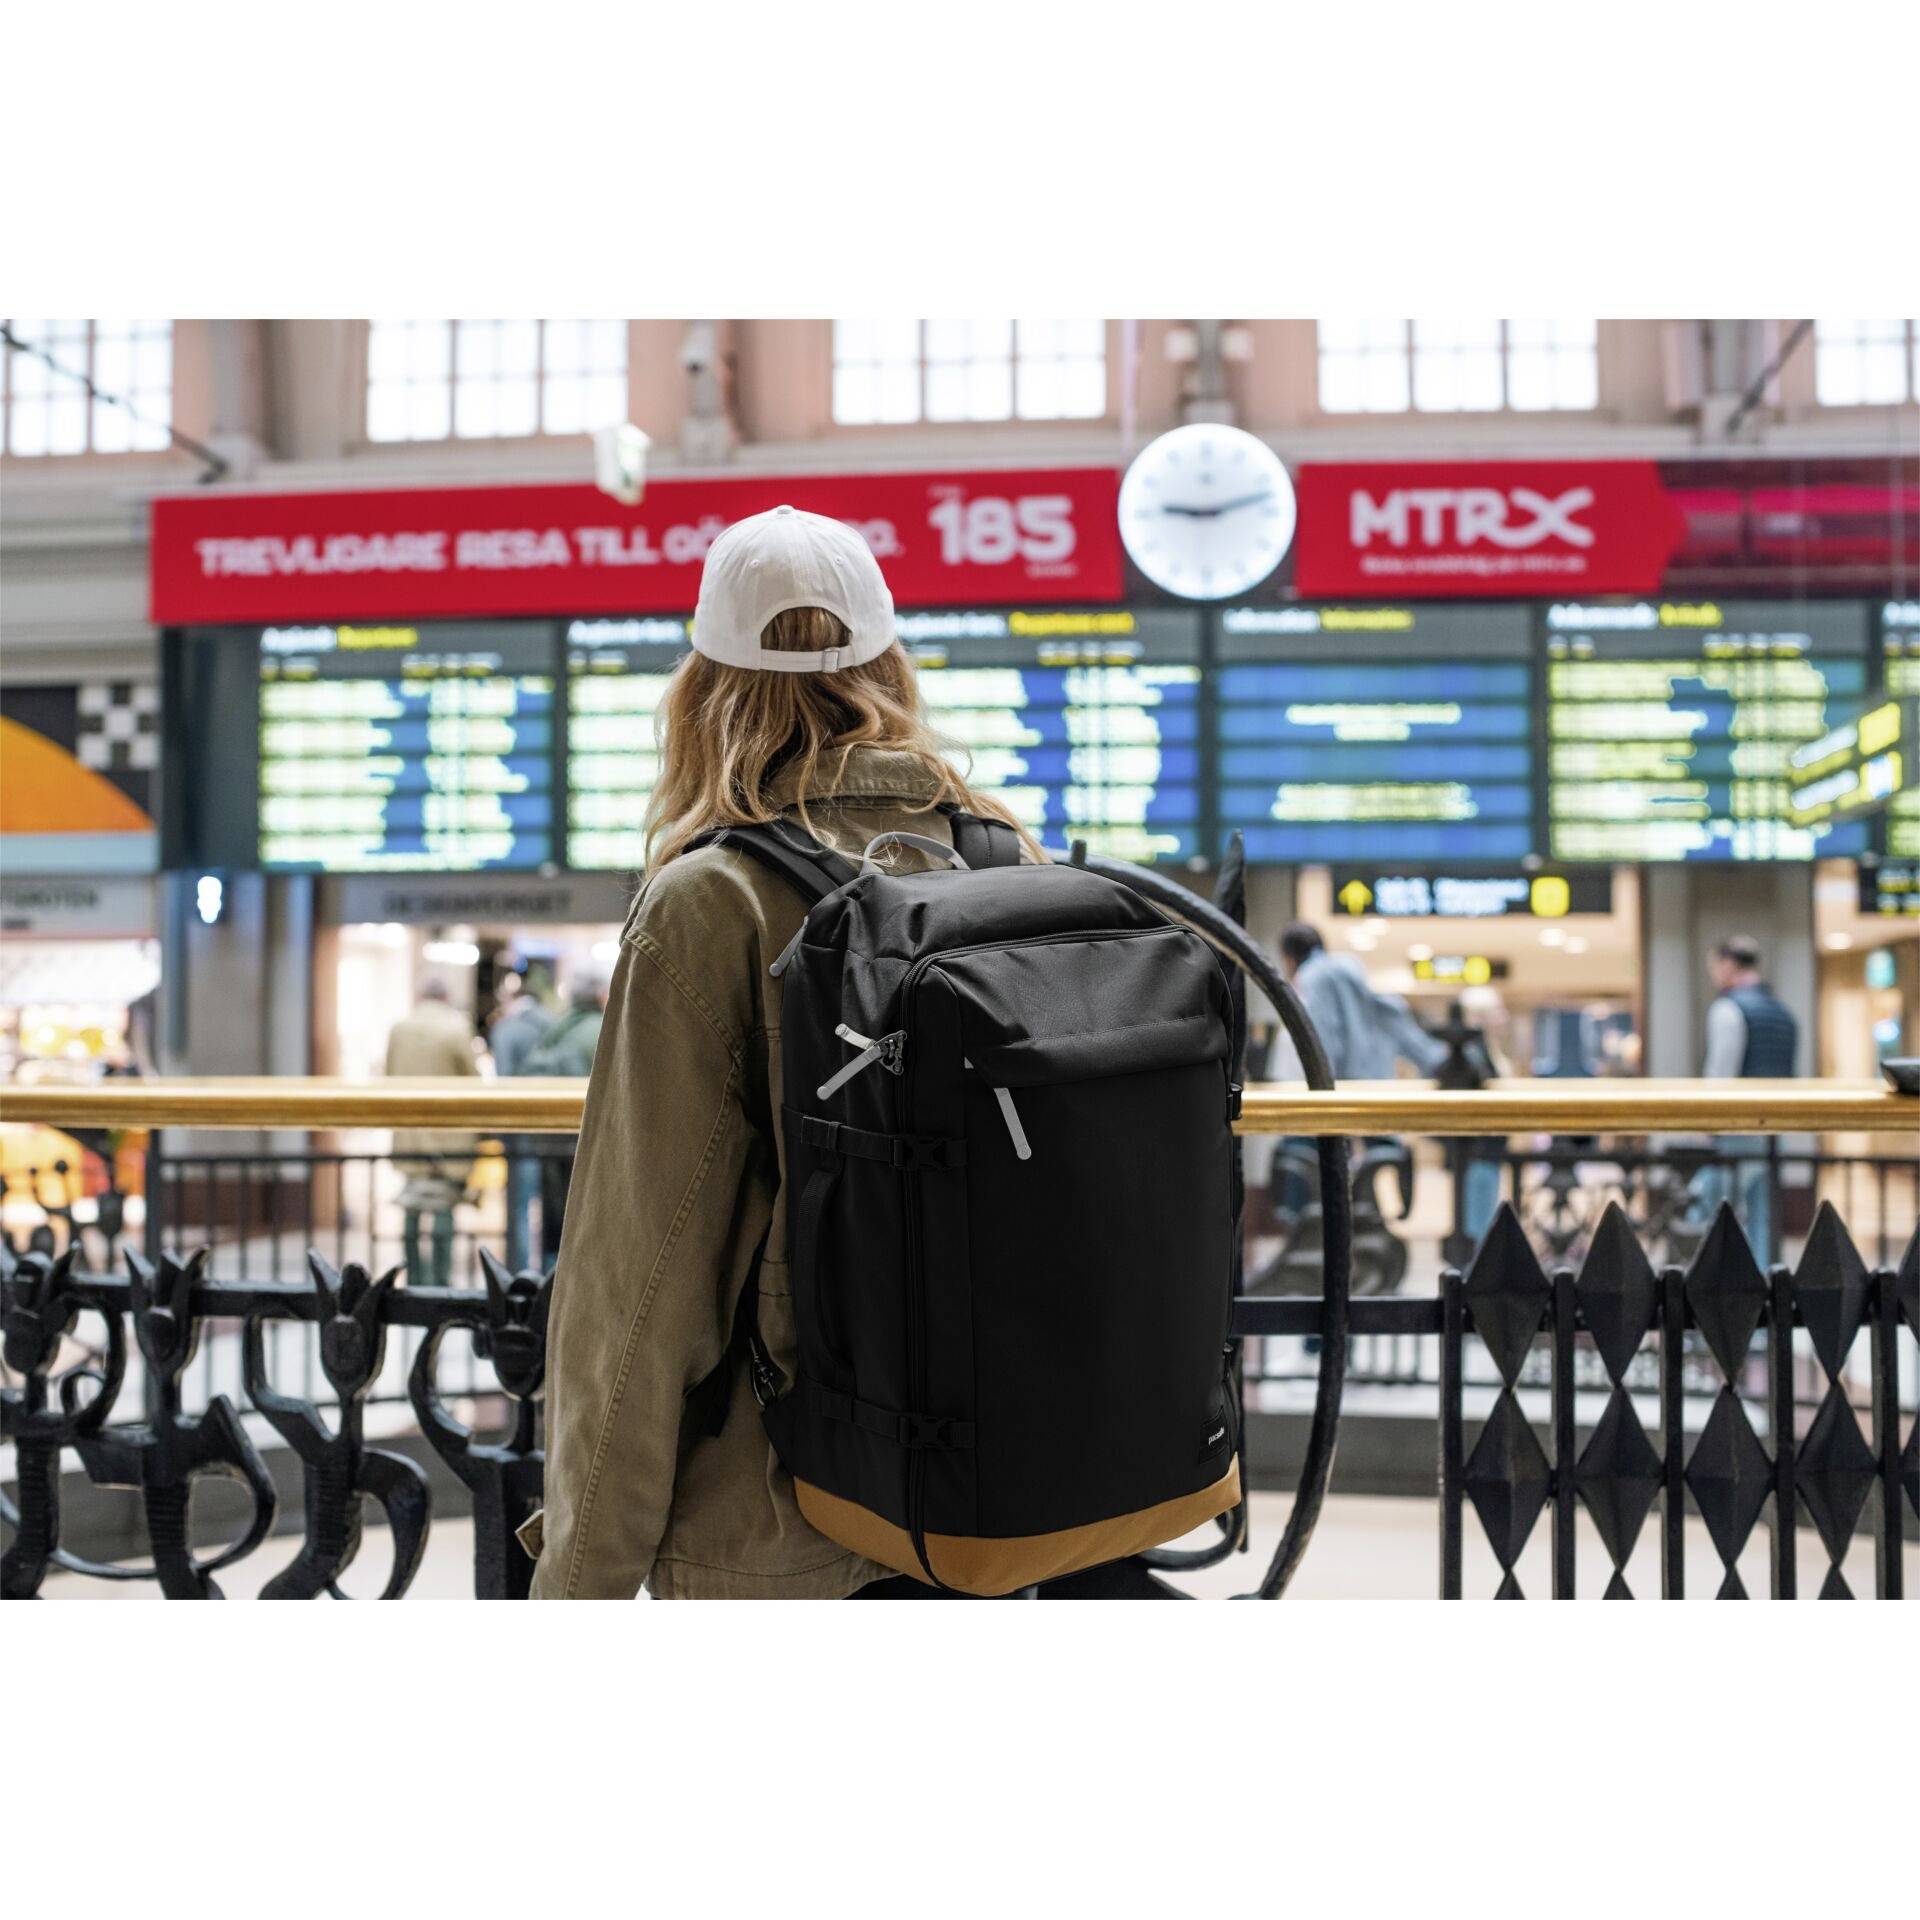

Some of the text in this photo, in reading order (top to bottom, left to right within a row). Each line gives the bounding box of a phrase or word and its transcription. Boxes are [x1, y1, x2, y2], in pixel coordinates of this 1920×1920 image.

[928, 495, 1077, 565] 185
[1351, 487, 1594, 548] MTRX
[195, 532, 447, 577] TREVLIGARE
[455, 529, 570, 569] RESA
[574, 526, 659, 565] TILL
